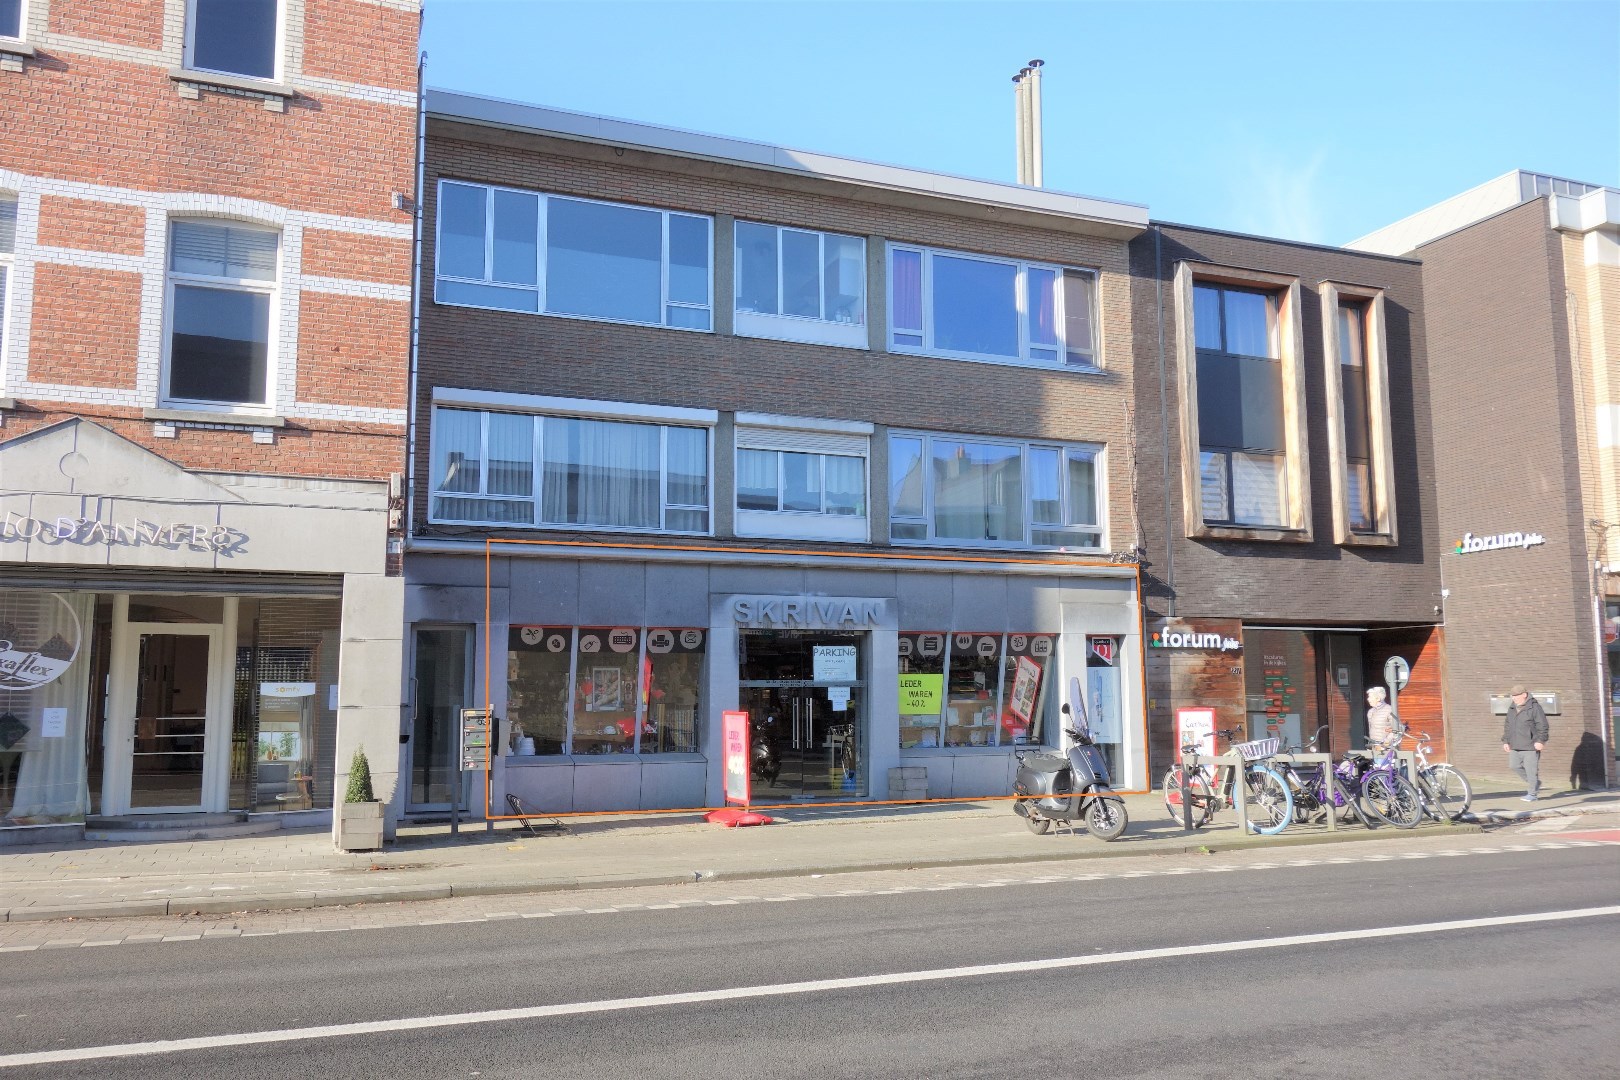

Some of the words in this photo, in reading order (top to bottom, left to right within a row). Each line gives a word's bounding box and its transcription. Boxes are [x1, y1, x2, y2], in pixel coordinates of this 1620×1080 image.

[1461, 532, 1523, 554] forum
[734, 600, 881, 626] SKRIVAN
[1161, 626, 1221, 648] forum
[813, 648, 856, 657] PARKING
[900, 680, 922, 688] LEDER
[908, 690, 933, 698] WAREN
